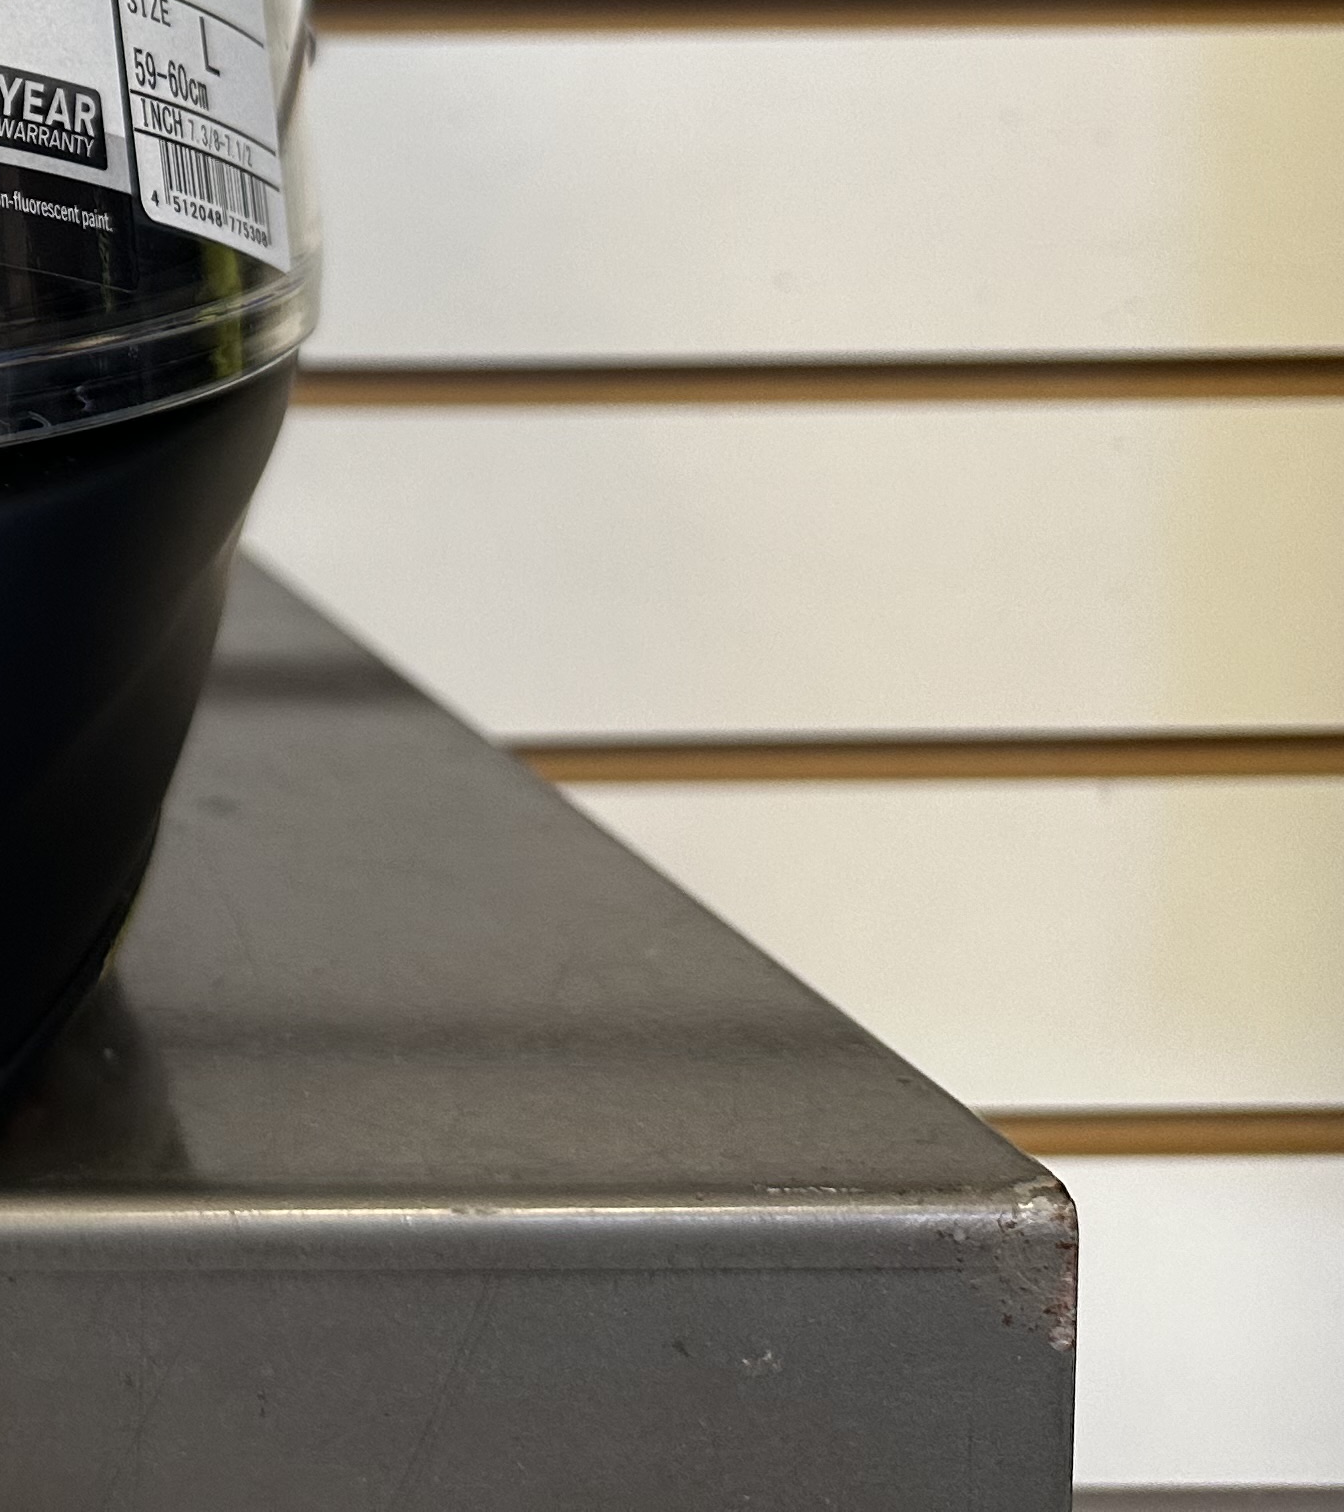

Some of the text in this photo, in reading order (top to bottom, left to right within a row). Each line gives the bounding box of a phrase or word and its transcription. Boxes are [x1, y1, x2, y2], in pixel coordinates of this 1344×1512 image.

[200, 16, 220, 77] L
[133, 47, 210, 111] 59-60cm
[141, 97, 184, 141] INCH
[82, 209, 114, 232] paint.
[151, 190, 159, 207] 4
[173, 196, 222, 228] 512048
